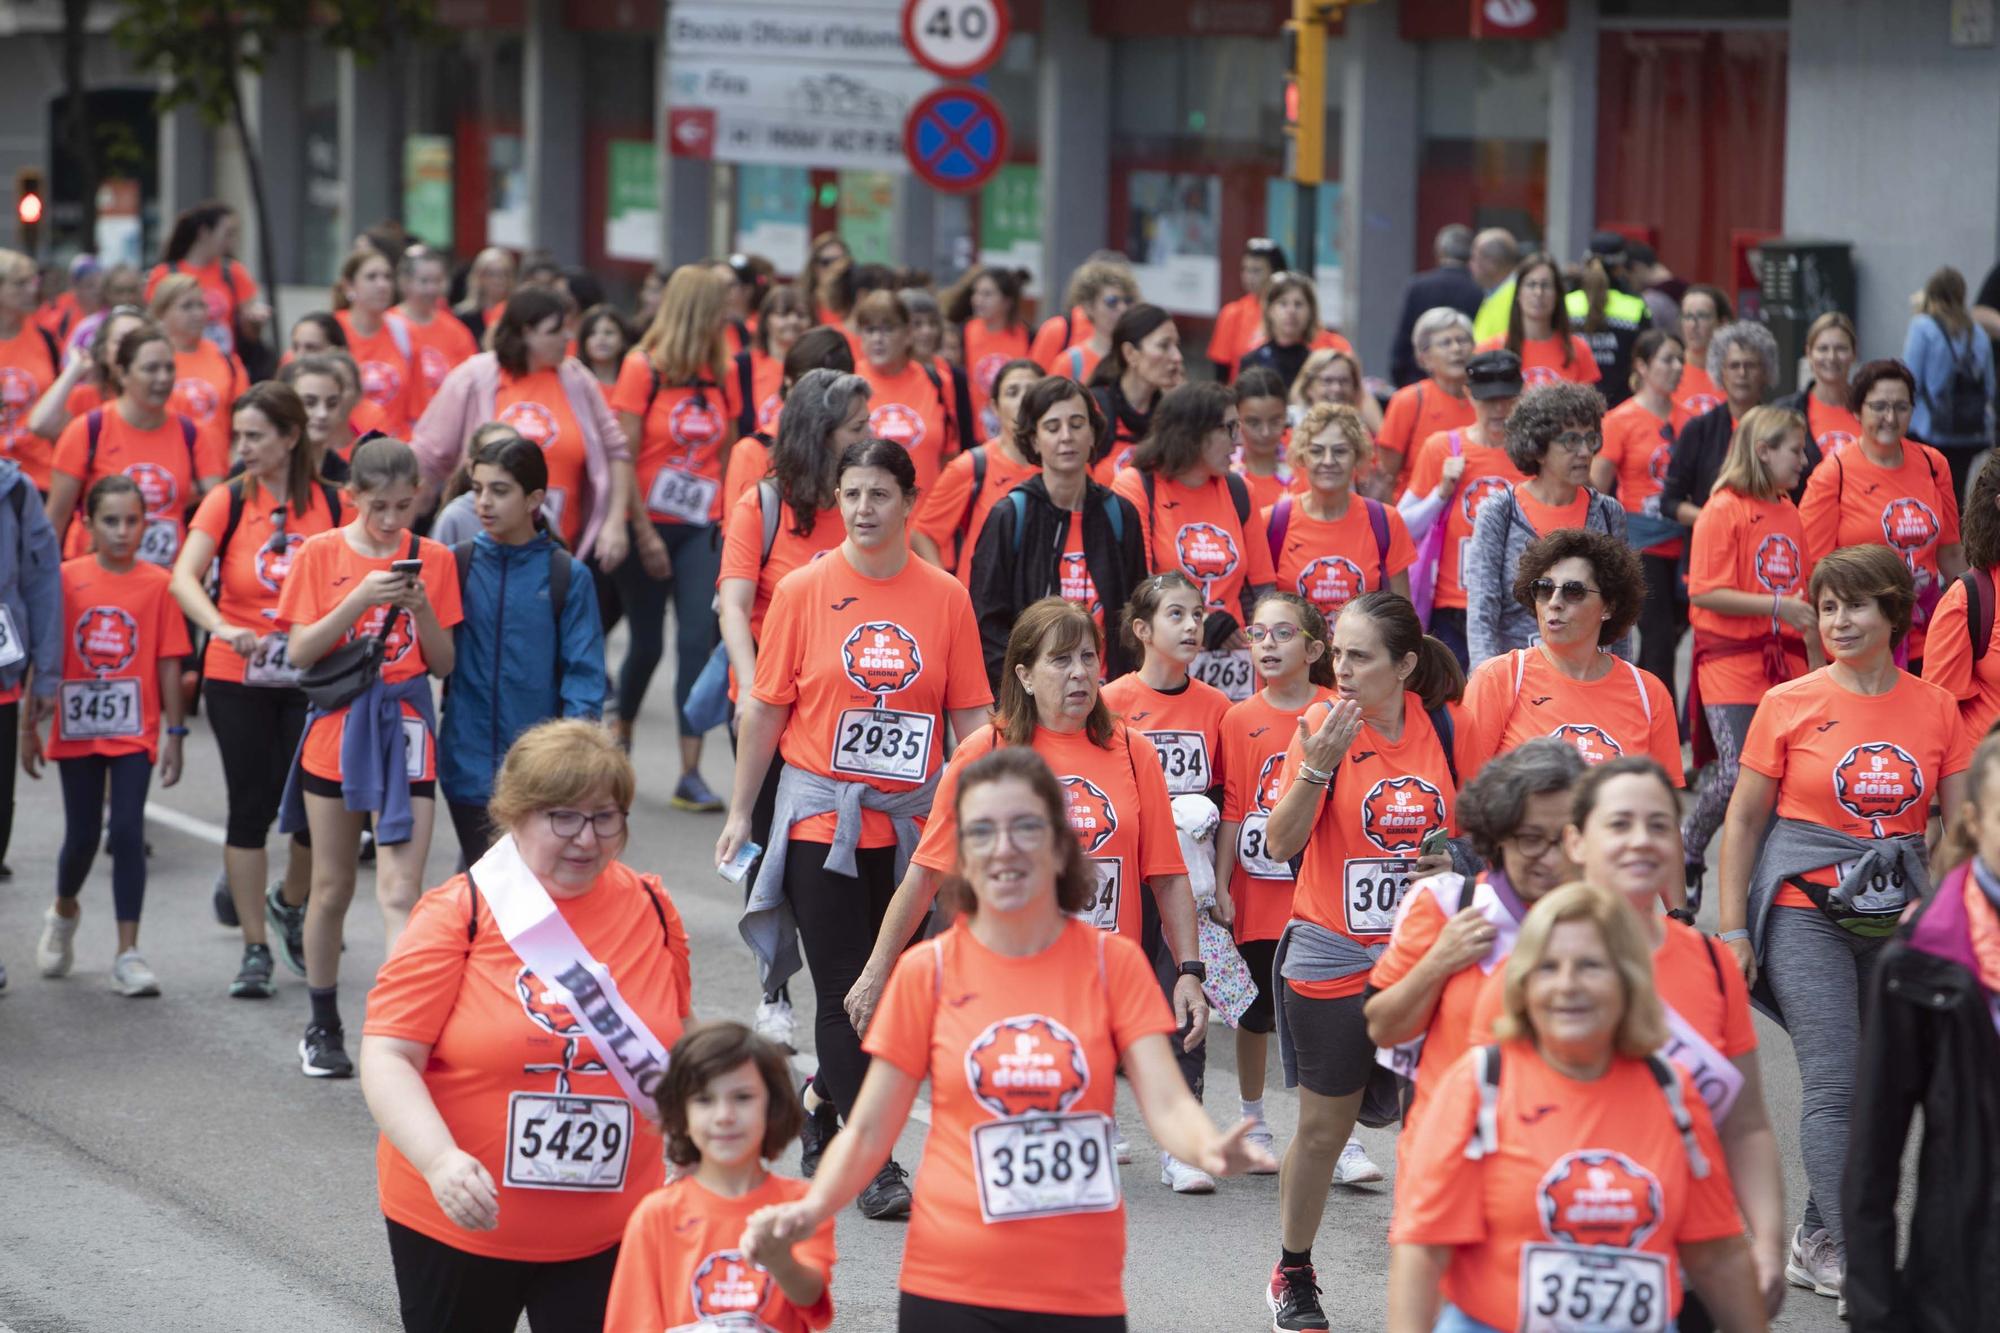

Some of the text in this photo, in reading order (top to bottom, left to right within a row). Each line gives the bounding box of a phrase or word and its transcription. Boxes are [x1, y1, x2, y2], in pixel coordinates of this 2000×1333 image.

[926, 6, 987, 40] 40
[863, 647, 900, 656] cursa
[859, 655, 905, 670] dona
[69, 693, 131, 721] 3451
[842, 723, 924, 761] 2935
[1871, 756, 1889, 771] 9ª
[1859, 772, 1900, 780] cursa
[1854, 781, 1905, 795] dona
[1395, 791, 1413, 806] 9ª
[1385, 804, 1425, 813] cursa
[1379, 813, 1427, 826] dona
[992, 1065, 1062, 1087] dona
[519, 1118, 622, 1163] 5429
[992, 1138, 1100, 1188] 3589
[1536, 1273, 1655, 1326] 3578
